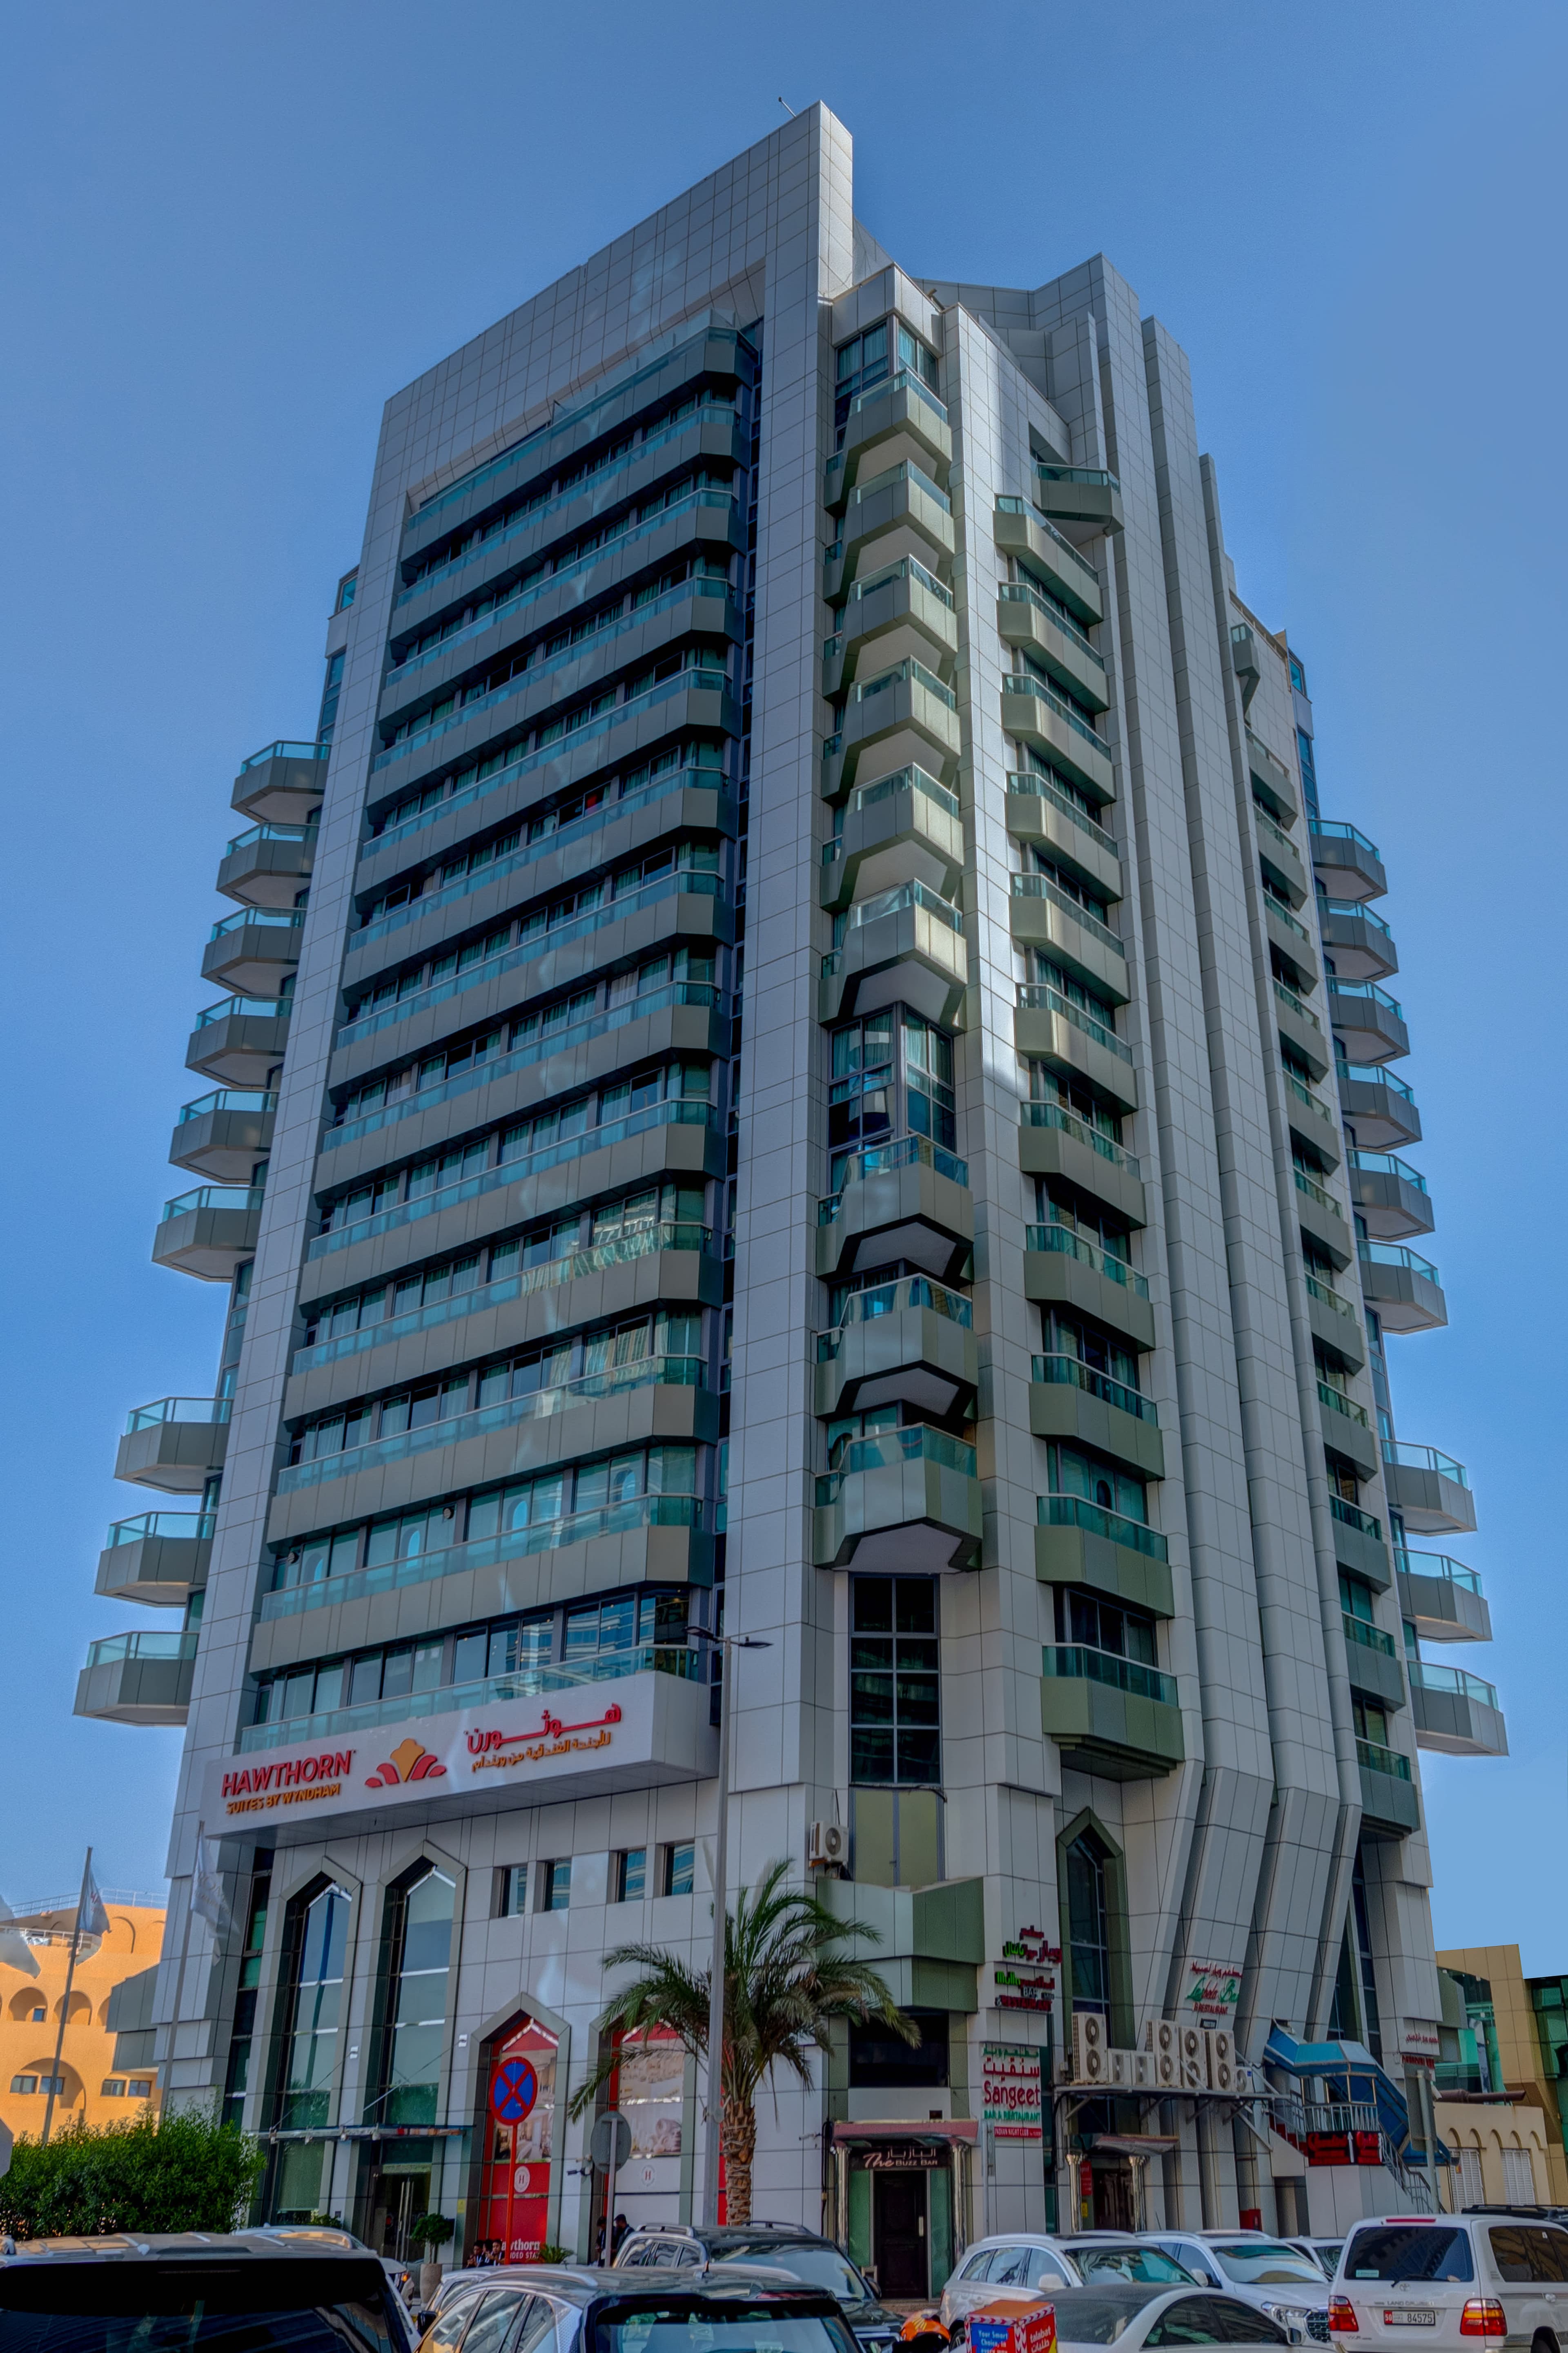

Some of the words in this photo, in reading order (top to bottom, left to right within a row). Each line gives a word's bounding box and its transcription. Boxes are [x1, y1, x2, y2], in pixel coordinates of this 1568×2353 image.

[467, 1702, 622, 1754] هوثورن
[508, 1752, 524, 1765] من
[221, 1750, 352, 1798] HAWTHORN
[227, 1797, 264, 1814] SUITES
[266, 1793, 282, 1808] BY
[282, 1782, 341, 1805] WYNDHAM
[1021, 1985, 1038, 1998] BAR
[1198, 2003, 1228, 2014] RESTAURANT
[983, 2057, 1039, 2082] سنقيت
[984, 2080, 1040, 2110] Sangeet
[984, 2110, 996, 2119] BAR
[1003, 2111, 1040, 2121] RESTAURANT
[863, 2152, 894, 2168] The
[501, 2238, 540, 2251] athorn
[1407, 2313, 1432, 2323] 84575
[992, 2331, 1008, 2340] Smart
[1030, 2325, 1051, 2344] talabat
[1031, 2338, 1050, 2353] طلبات
